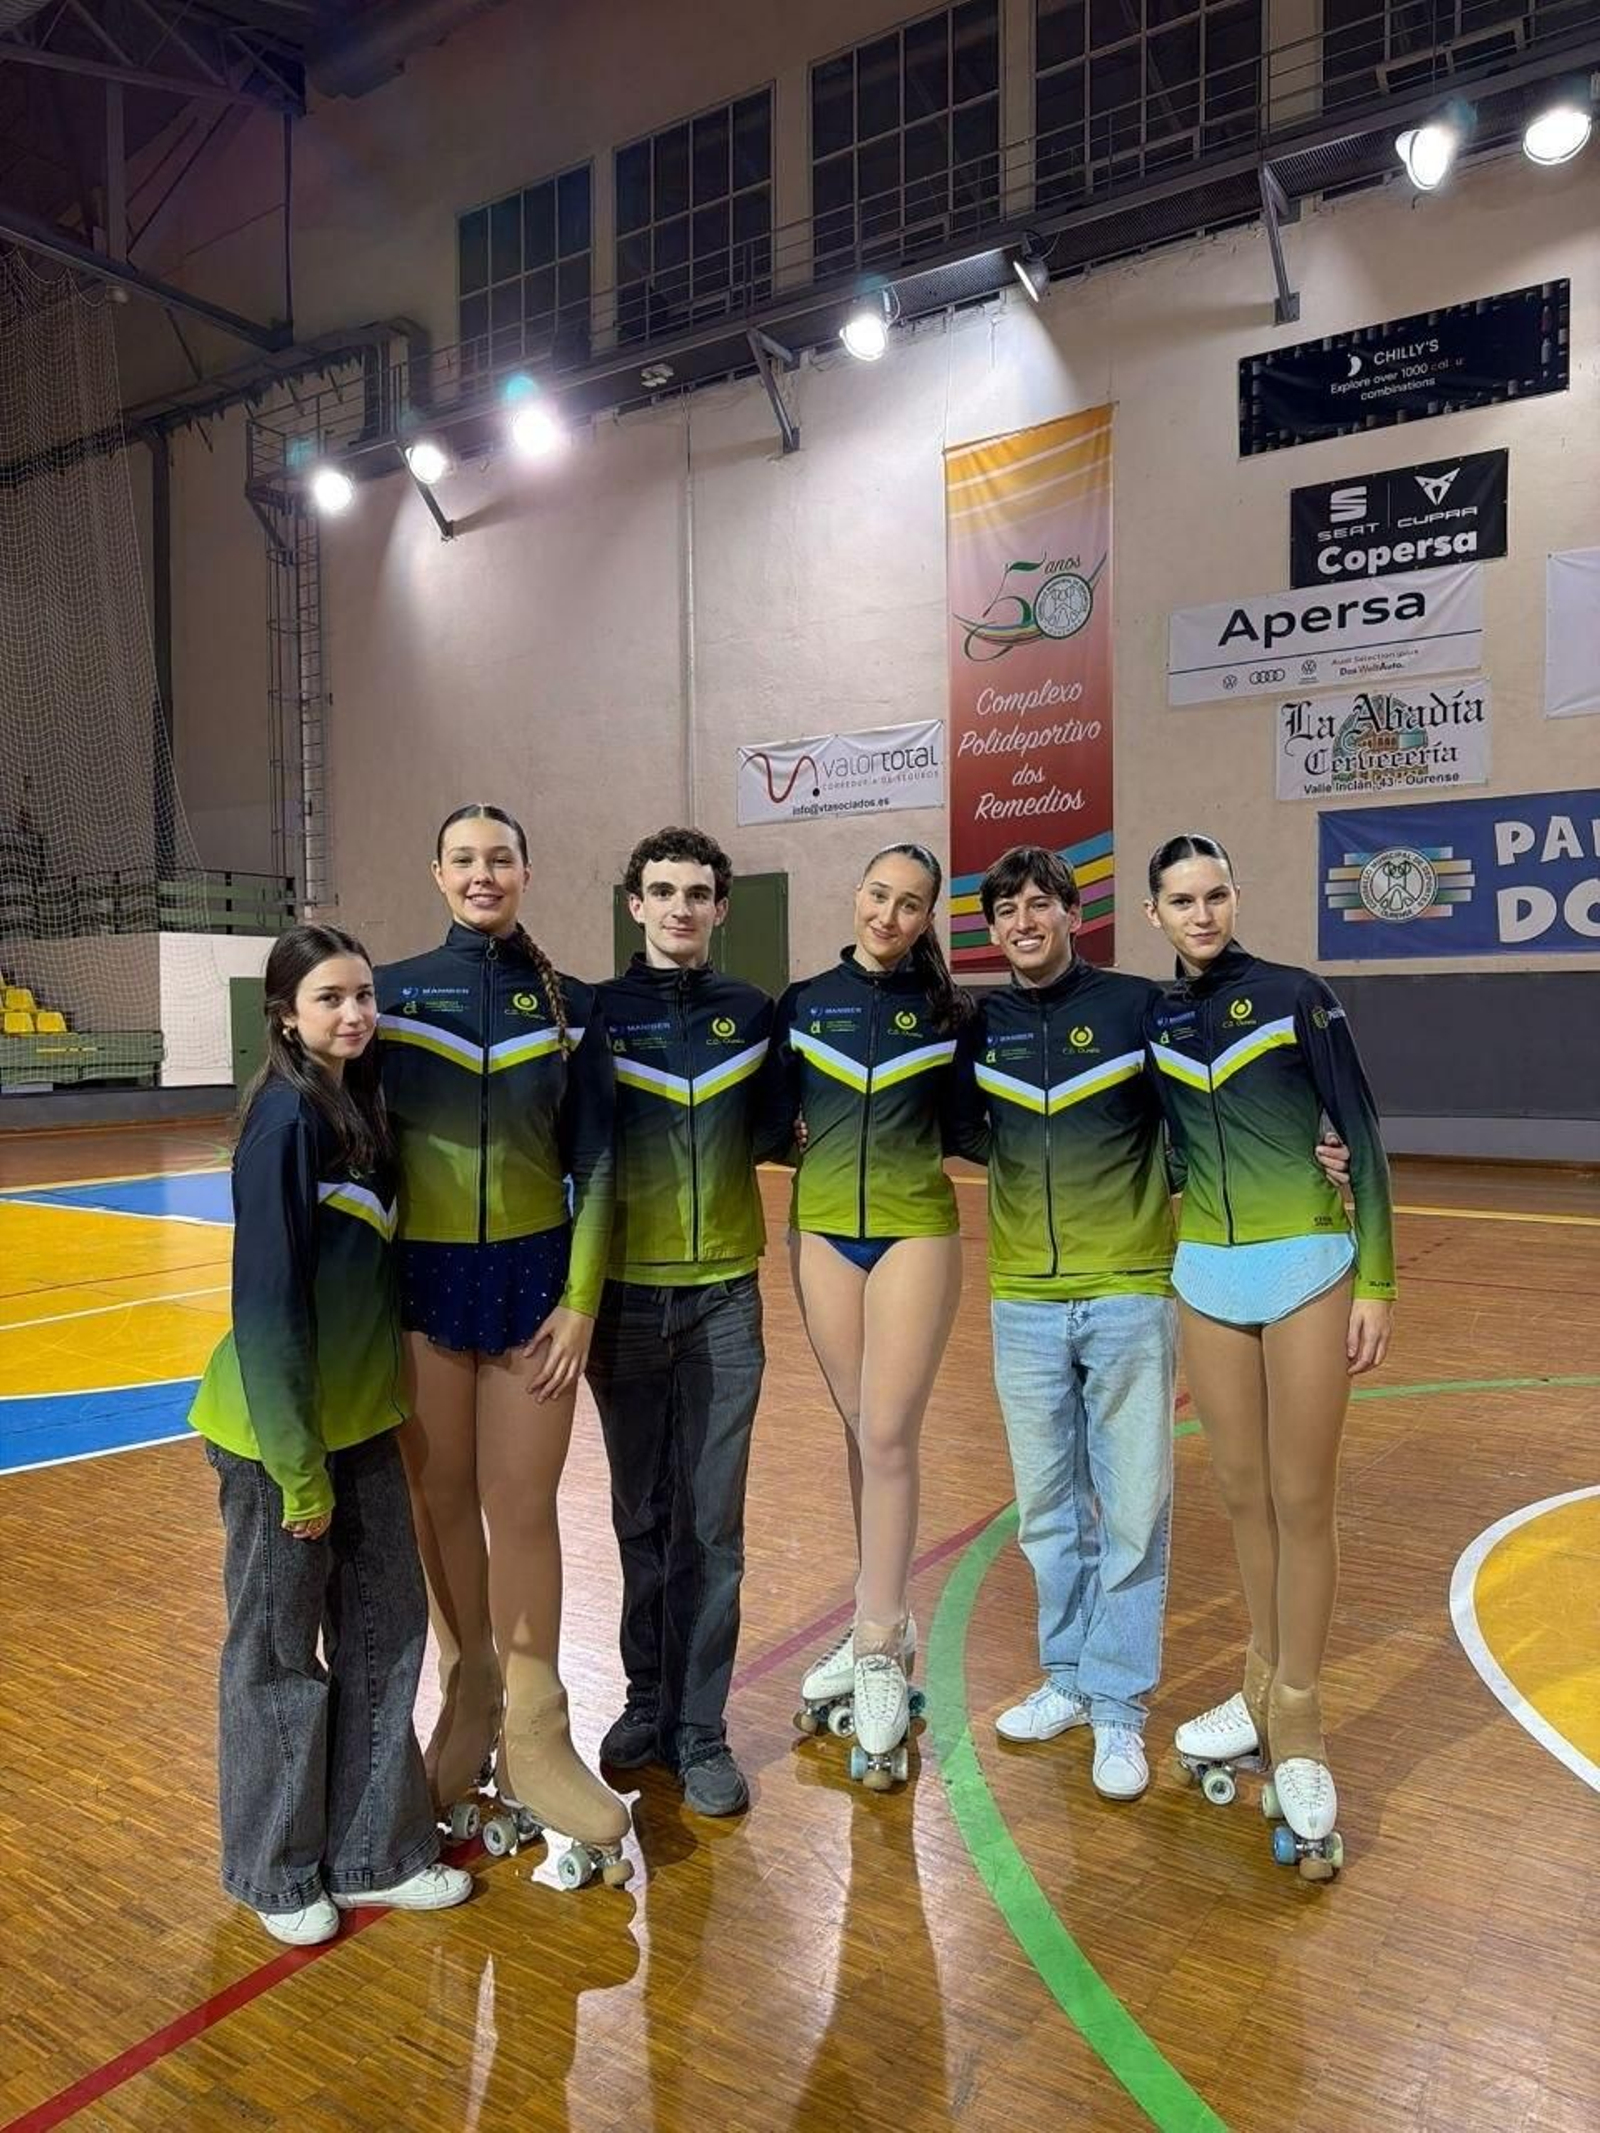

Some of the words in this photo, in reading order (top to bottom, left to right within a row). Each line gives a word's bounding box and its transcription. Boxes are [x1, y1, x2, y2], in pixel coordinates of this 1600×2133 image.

[1374, 339, 1439, 365] CHILLY'S
[1331, 377, 1370, 394] Explore
[1373, 372, 1398, 384] over
[1401, 363, 1428, 378] 1000
[1361, 377, 1436, 400] combinations
[1317, 522, 1380, 542] SEAT
[1397, 506, 1478, 528] CUPRA
[1045, 555, 1081, 574] anos
[1317, 531, 1478, 575] Copersa
[1218, 591, 1426, 648] Apersa
[976, 679, 1082, 716] Complexo
[958, 718, 1101, 757] Polideportivo
[1281, 700, 1335, 757] La
[1343, 690, 1485, 735] Abadía
[1012, 763, 1045, 786] dos
[1304, 742, 1459, 776] Cervecería
[1379, 779, 1394, 788] 43
[1406, 772, 1460, 786] Ourense
[974, 785, 1085, 820] Remedios
[1494, 815, 1600, 866] PA
